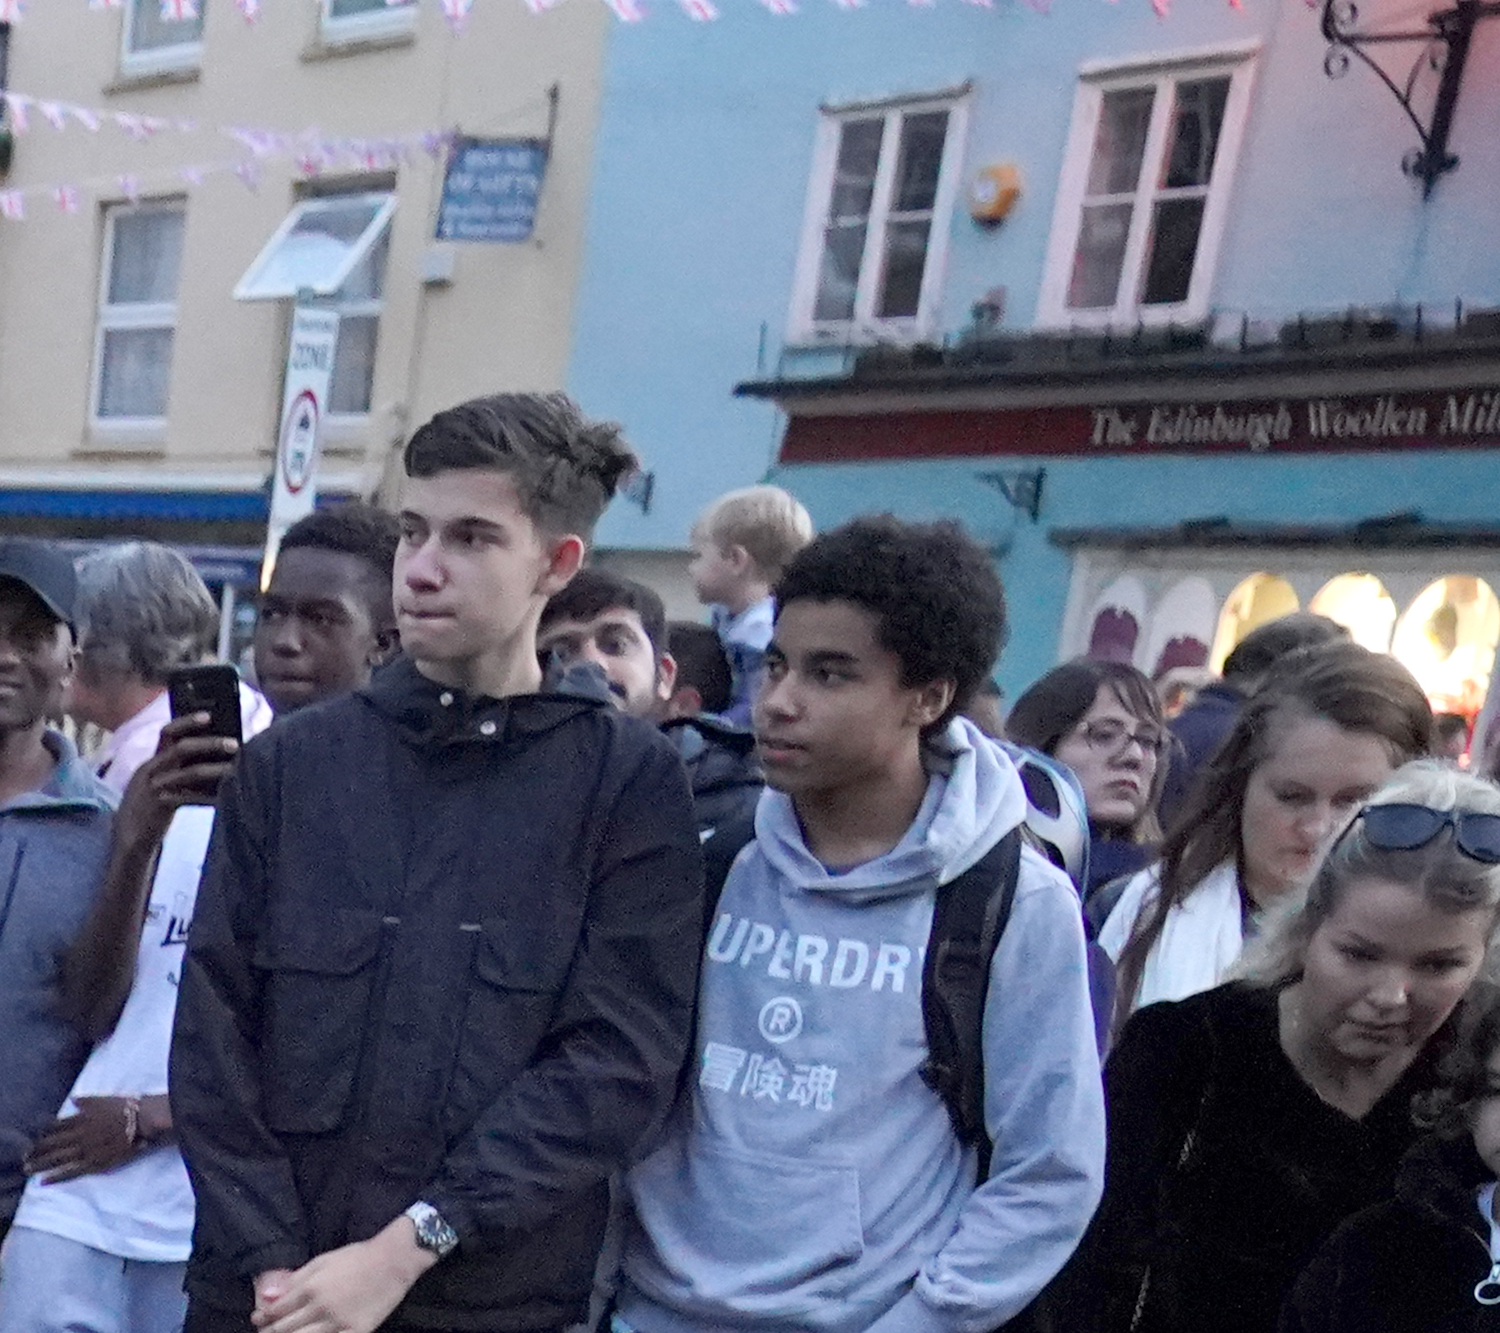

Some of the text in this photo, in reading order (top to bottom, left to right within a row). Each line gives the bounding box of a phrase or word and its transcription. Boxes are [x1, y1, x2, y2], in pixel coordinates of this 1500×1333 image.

[1089, 391, 1500, 451] The Edinburgh Woollen Mil
